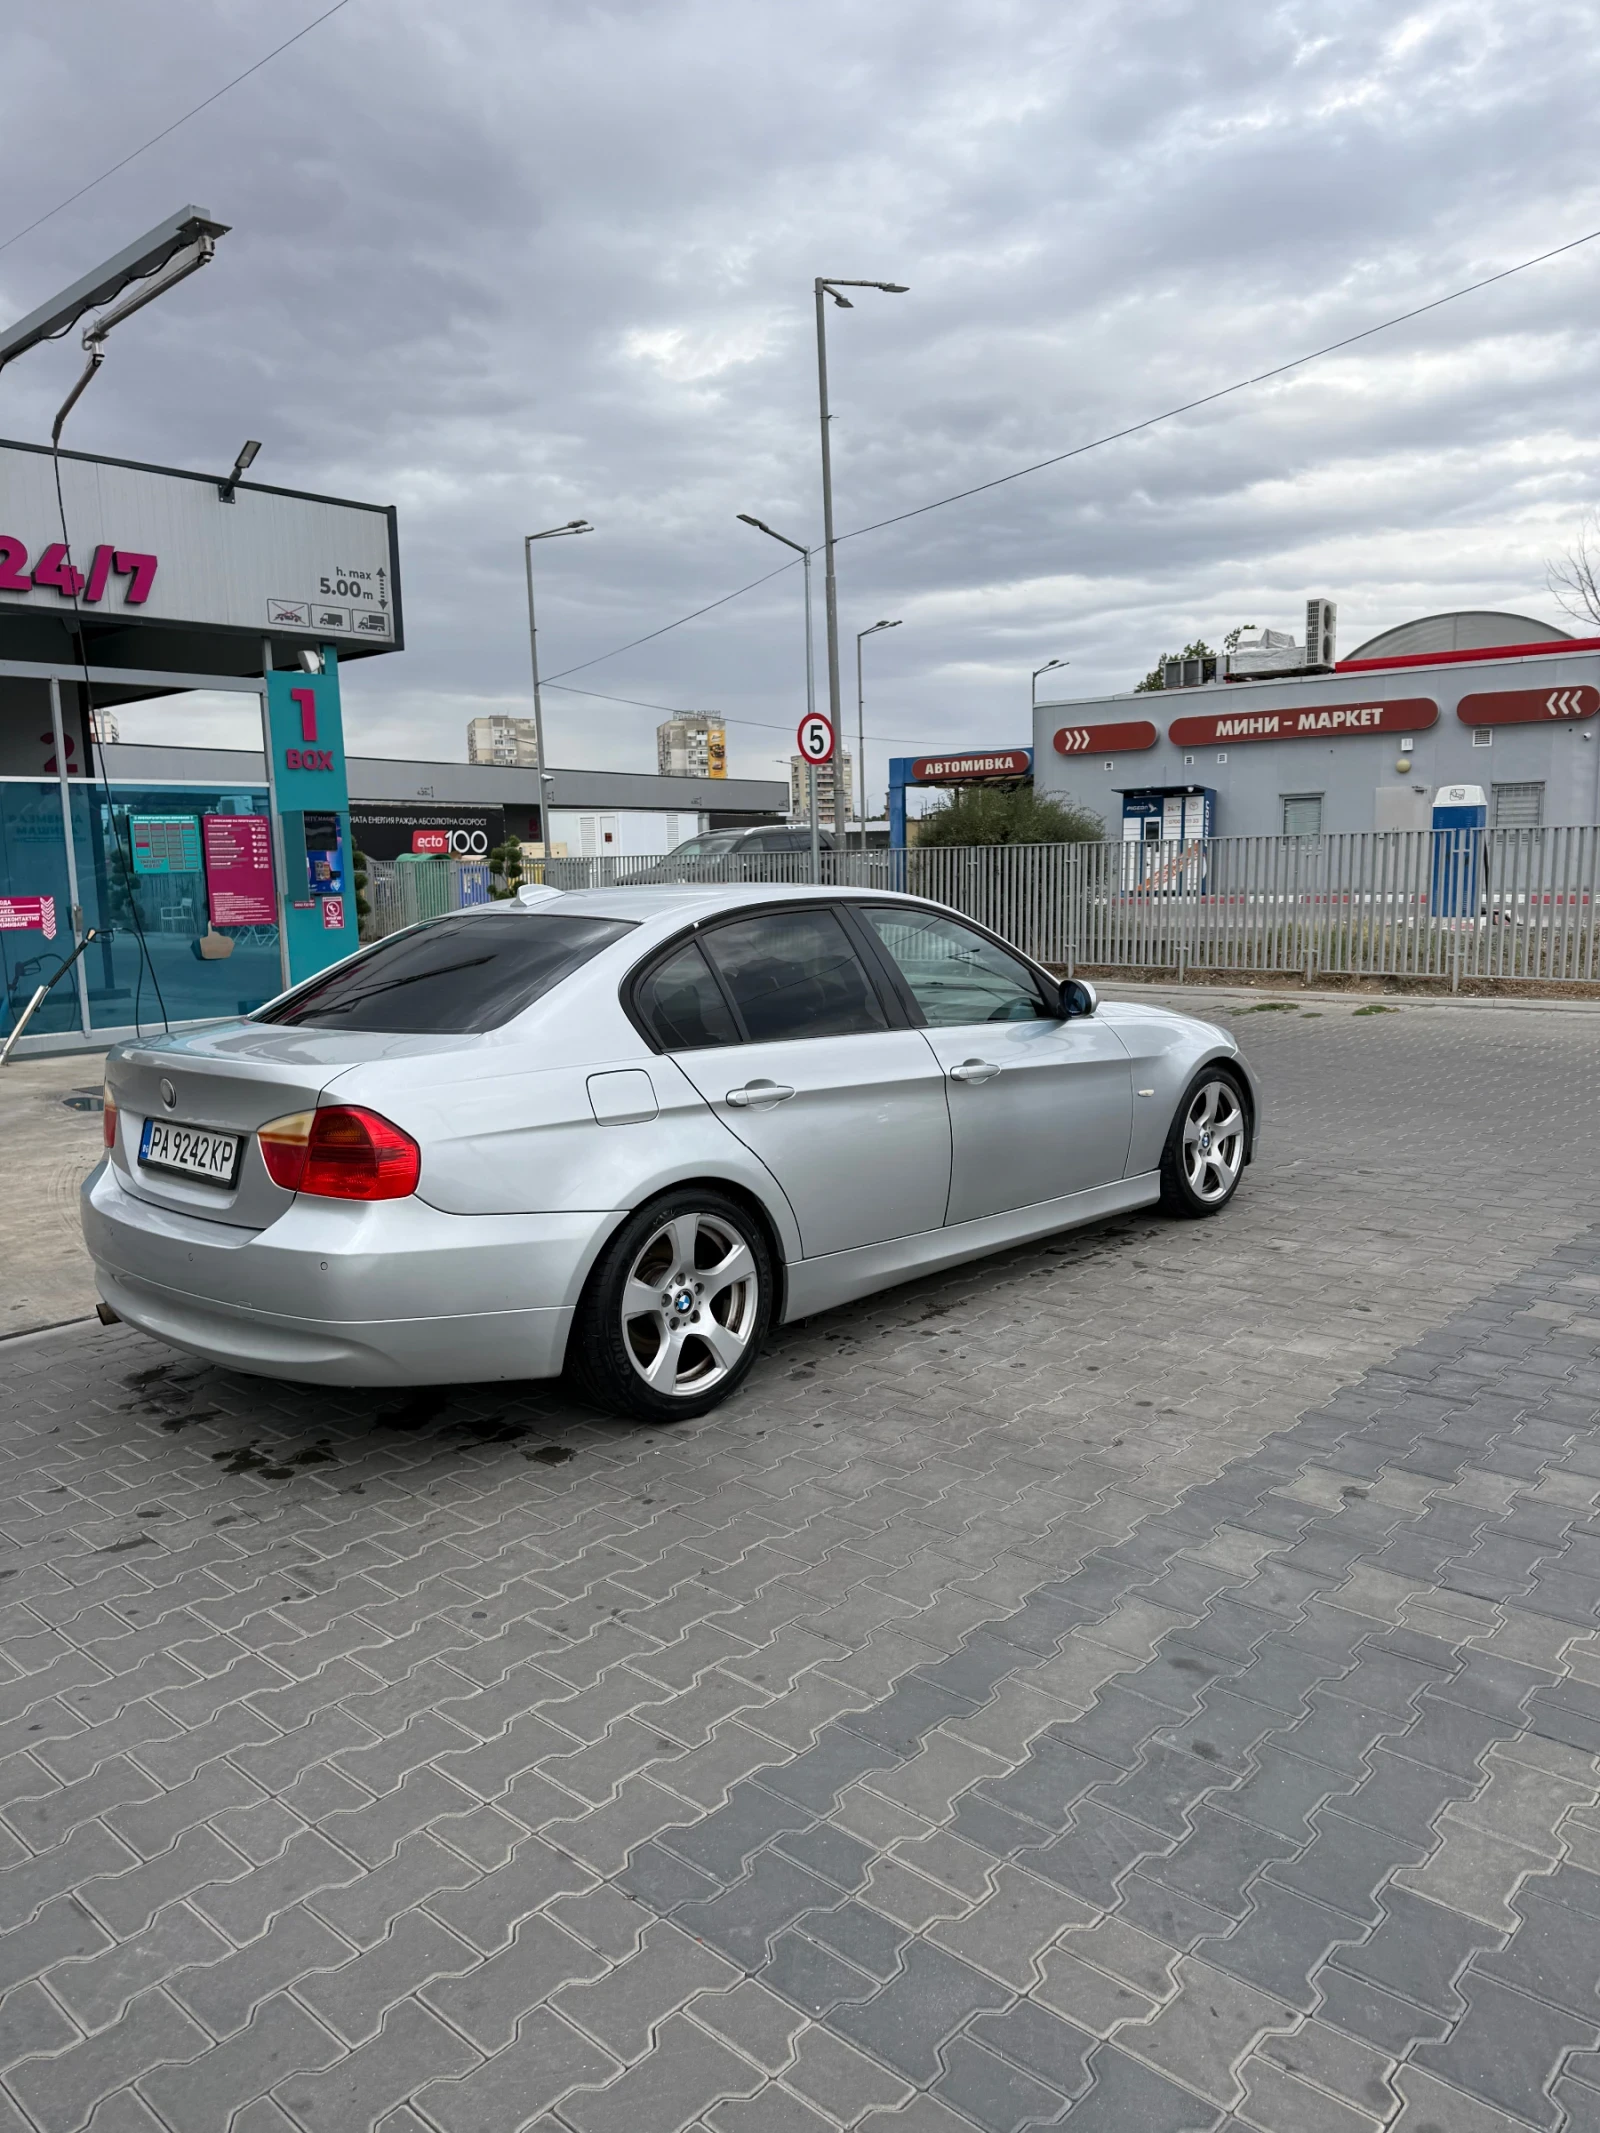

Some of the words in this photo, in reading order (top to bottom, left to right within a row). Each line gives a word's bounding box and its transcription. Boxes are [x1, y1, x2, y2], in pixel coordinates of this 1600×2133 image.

[0, 535, 158, 603] 24/7
[349, 569, 372, 580] max
[291, 688, 317, 741] 1
[1215, 716, 1279, 736] МИНИ
[1297, 708, 1384, 731] МАРКЕТ
[40, 732, 78, 773] 2
[809, 724, 825, 755] 5
[286, 748, 334, 771] BOX
[924, 756, 1015, 775] АВТОМИВКА
[368, 816, 395, 825] ЕНЕРГИЯ
[395, 817, 418, 826] РАЖДА
[418, 817, 458, 826] АБСОЛЮТНА
[459, 818, 487, 827] СКОРОСТ
